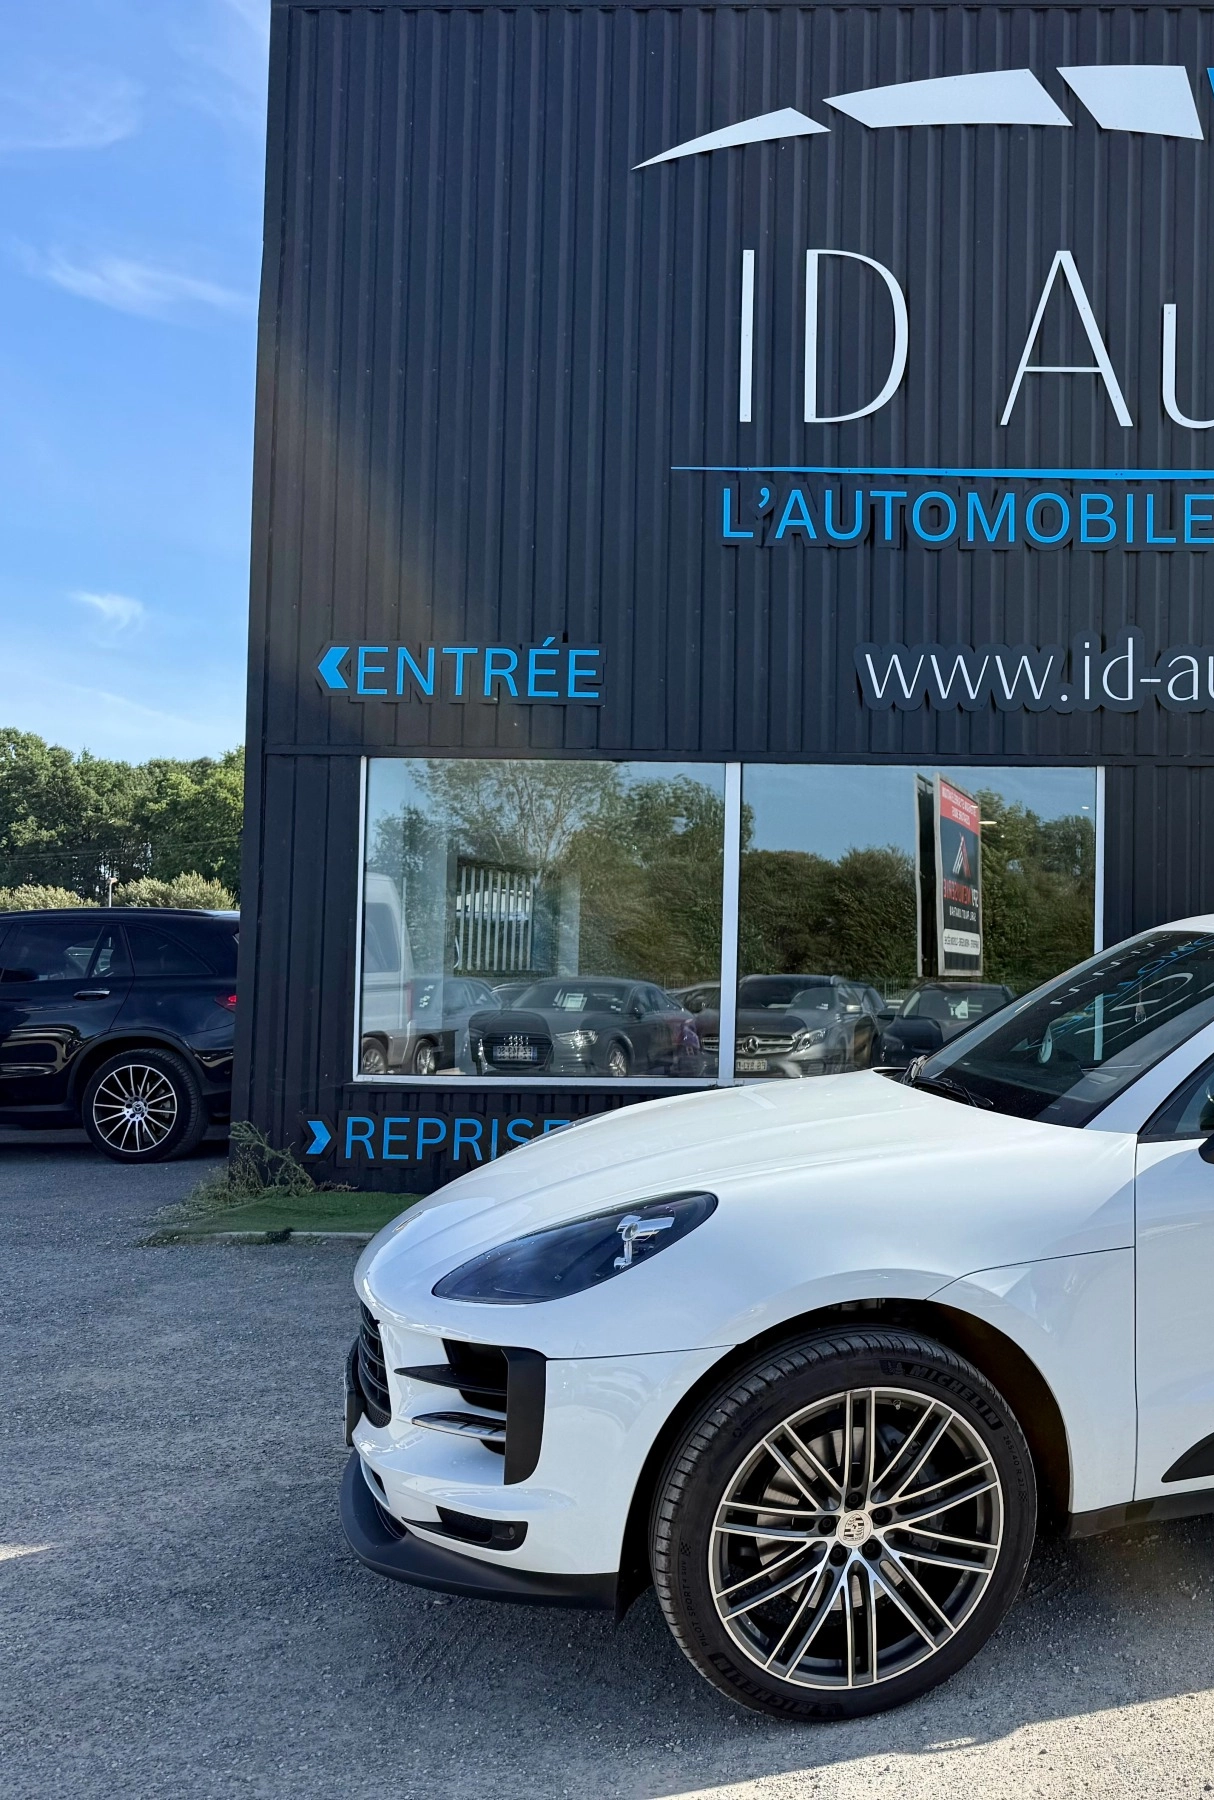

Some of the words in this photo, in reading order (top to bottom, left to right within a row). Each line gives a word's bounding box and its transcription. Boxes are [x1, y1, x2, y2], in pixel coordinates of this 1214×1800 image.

[739, 249, 909, 423] ID
[356, 636, 600, 698] ENTRÉE
[908, 1366, 1000, 1430] MICHELIN
[682, 1584, 696, 1617] SPORT
[691, 1621, 709, 1648] PILOT
[713, 1655, 815, 1715] MICHELIN
